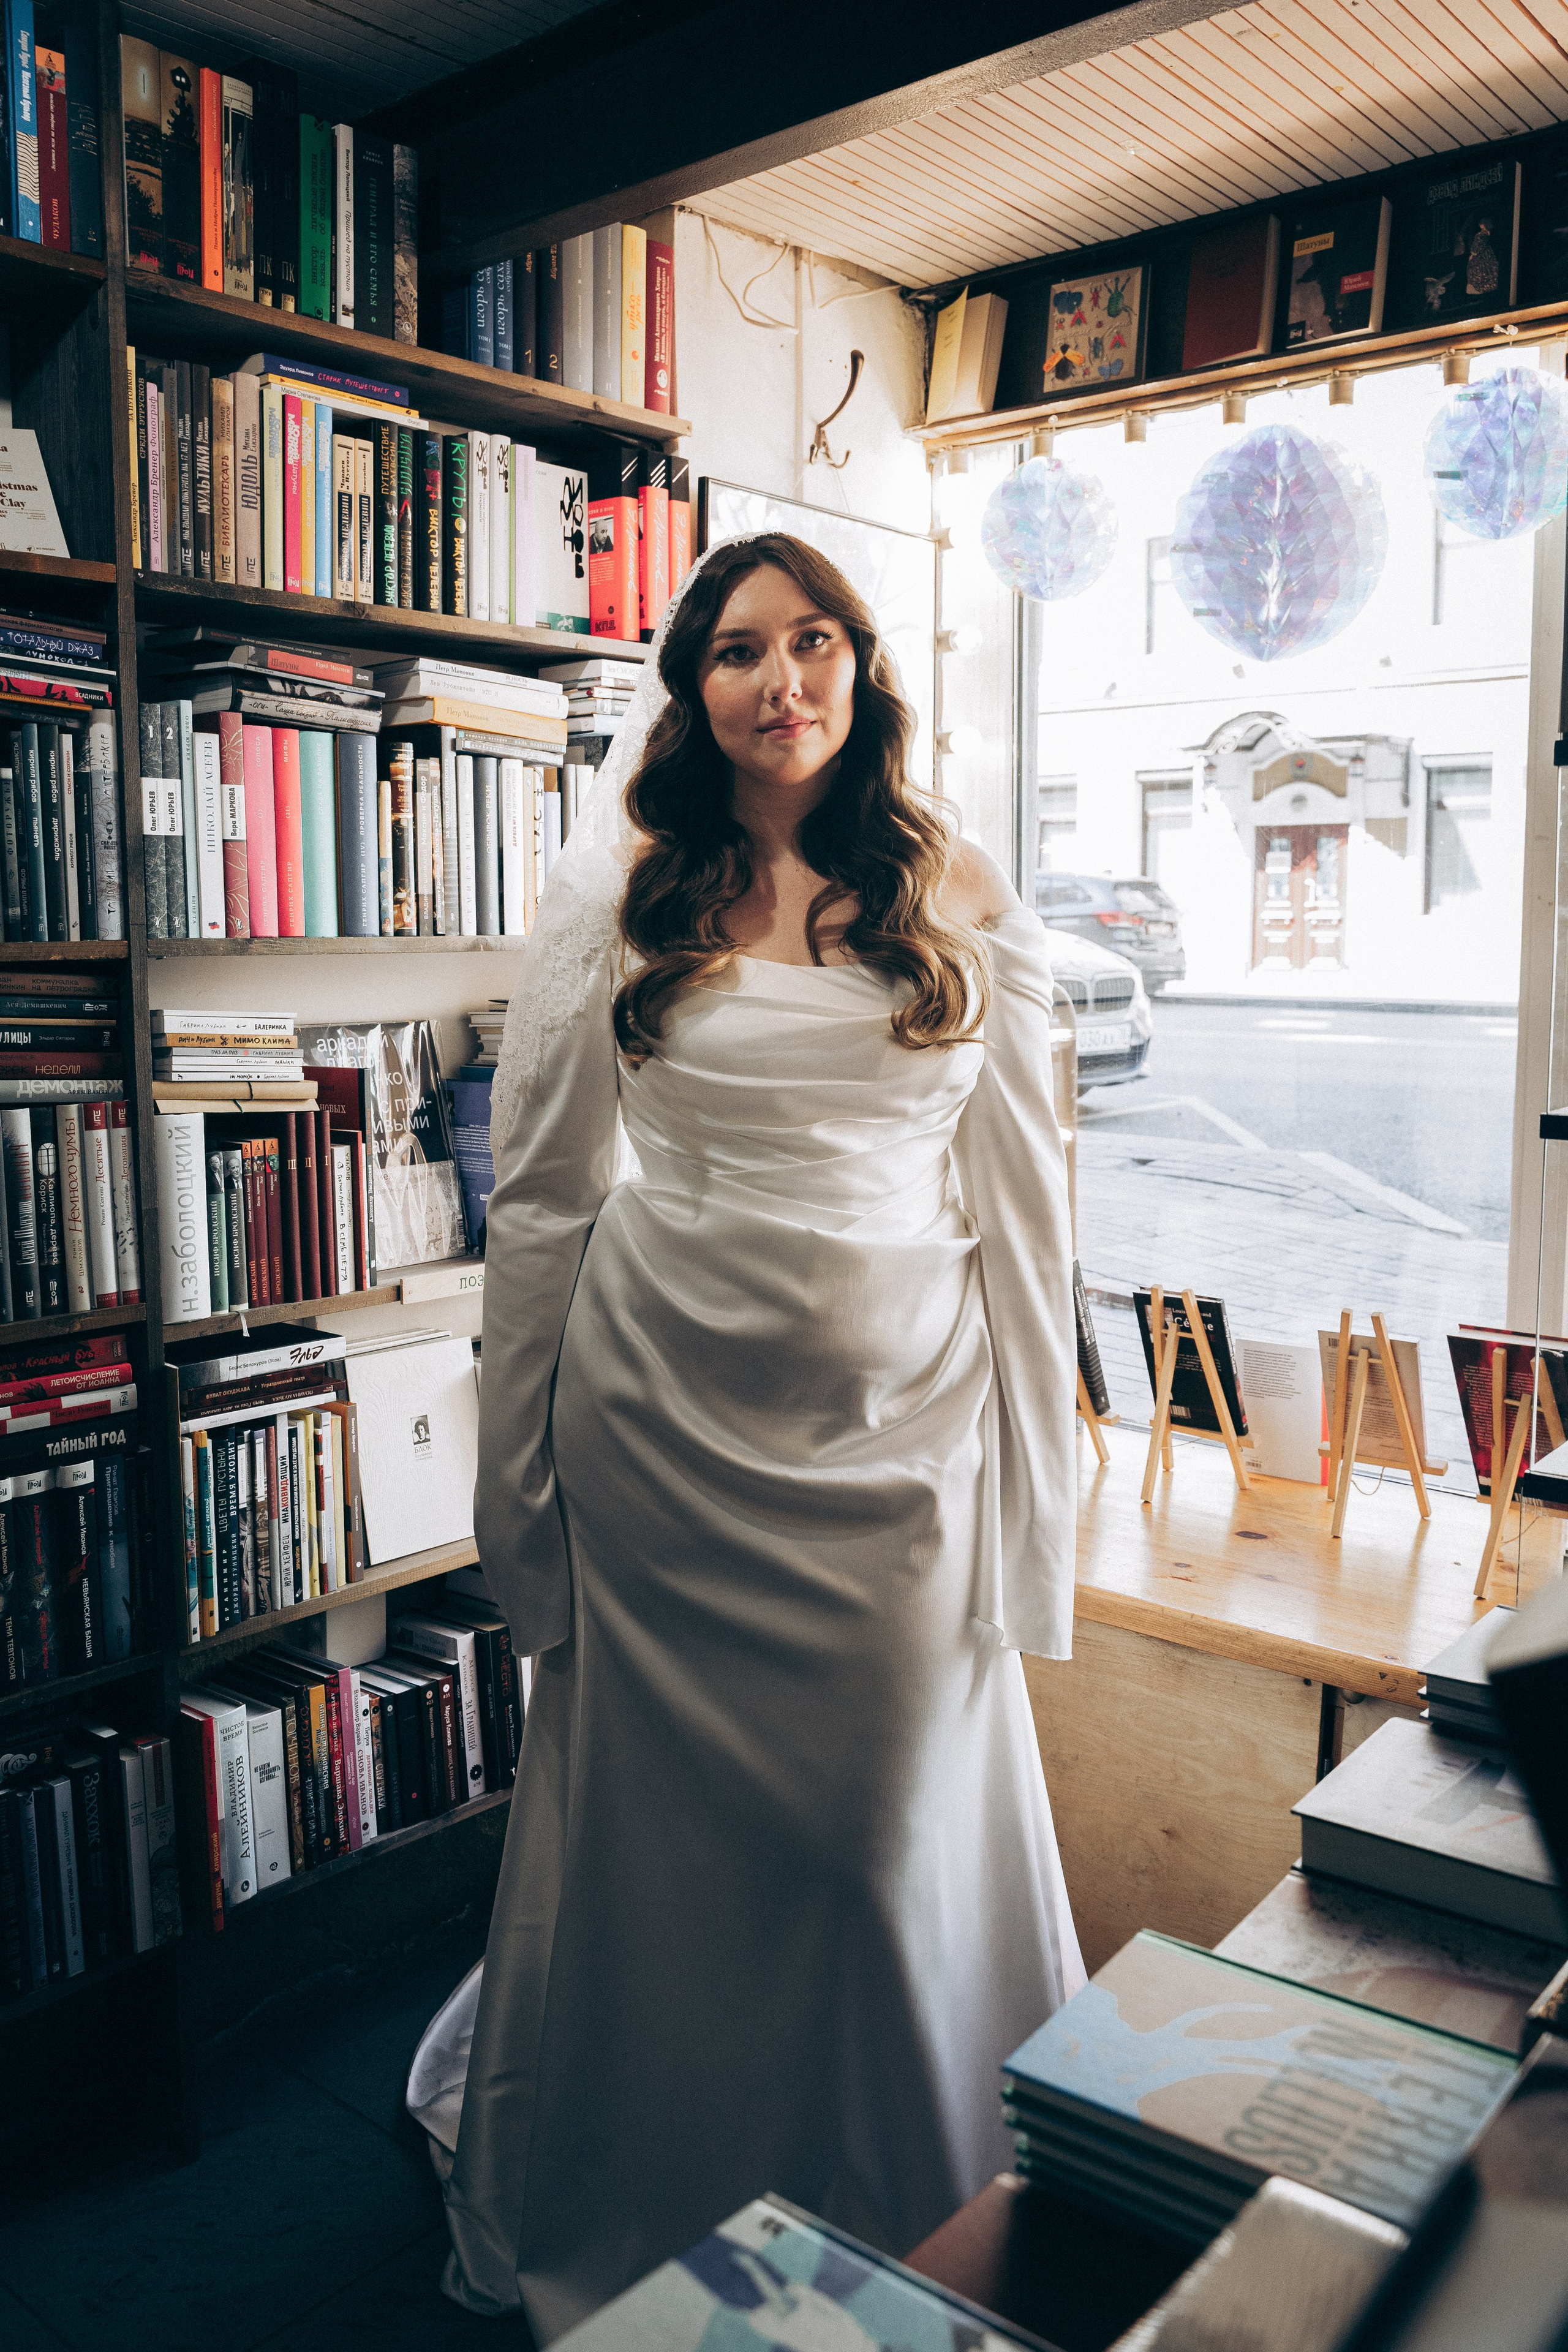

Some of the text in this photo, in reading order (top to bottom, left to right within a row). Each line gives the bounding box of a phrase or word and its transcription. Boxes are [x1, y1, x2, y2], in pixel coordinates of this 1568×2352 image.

[280, 386, 296, 396] Мария
[296, 390, 322, 402] Степанова
[149, 396, 157, 447] Фонограф
[150, 450, 159, 486] Бренер
[181, 462, 188, 472] НА
[381, 425, 390, 495] ПУТЕШЕСТВИЕ
[197, 444, 210, 516] МУЛЬТИКИ
[241, 454, 260, 511] ЮДОЛЬ
[221, 454, 230, 547] БИБЛИОТЕКАРЬ
[182, 530, 189, 541] МЫ
[429, 508, 439, 610] ВИКТОР ПЕЛЕВИН
[385, 562, 395, 605] ВИКТОР
[19, 621, 64, 632] фармакология
[271, 658, 300, 671] Шатуны
[435, 663, 475, 677] Петр Мамонов
[75, 692, 104, 701] ВСАДНИКИ
[446, 707, 489, 722] Петр Мамонов
[203, 741, 216, 853] НИКОЛАЙ АСЕЕВ
[52, 817, 62, 861] дирижабль
[16, 1079, 124, 1098] демонтаж
[65, 1116, 83, 1233] Немного чумы
[95, 1137, 105, 1183] Десятые
[39, 1178, 47, 1214] Кориск
[48, 1177, 58, 1266] Каллиопа, дерево,
[50, 1368, 120, 1387] ЛЕТОИСЧИСЛЕНИЕ
[228, 1356, 282, 1371] Борис Белокуров (Усов)
[88, 1377, 120, 1388] ИОАННА
[206, 1390, 223, 1400] БУЛАТ
[222, 1385, 251, 1397] ОКУДЖАВА
[260, 1378, 292, 1389] Упраздненный
[46, 1429, 127, 1457] ТАЙНЫЙ ГОД
[414, 1443, 432, 1455] БЛОК
[217, 1447, 228, 1532] ЦВЕТЫ ПУСТЫНИ
[280, 1455, 290, 1525] ИНАКОВИДЯЩИЙ
[282, 1534, 291, 1567] ХЕЙФЕЦ
[82, 1578, 91, 1628] НЕВЬЯНСКАЯ
[7, 1638, 16, 1680] ТЕВТОНОВ
[220, 1720, 245, 1735] ЧИСТОЕ
[223, 1729, 243, 1743] ВРЕМЯ
[227, 1761, 238, 1818] ВЛАДИМИР
[334, 1758, 343, 1802] Варшава,
[236, 1755, 251, 1859] АЛЕЙНИКОВ
